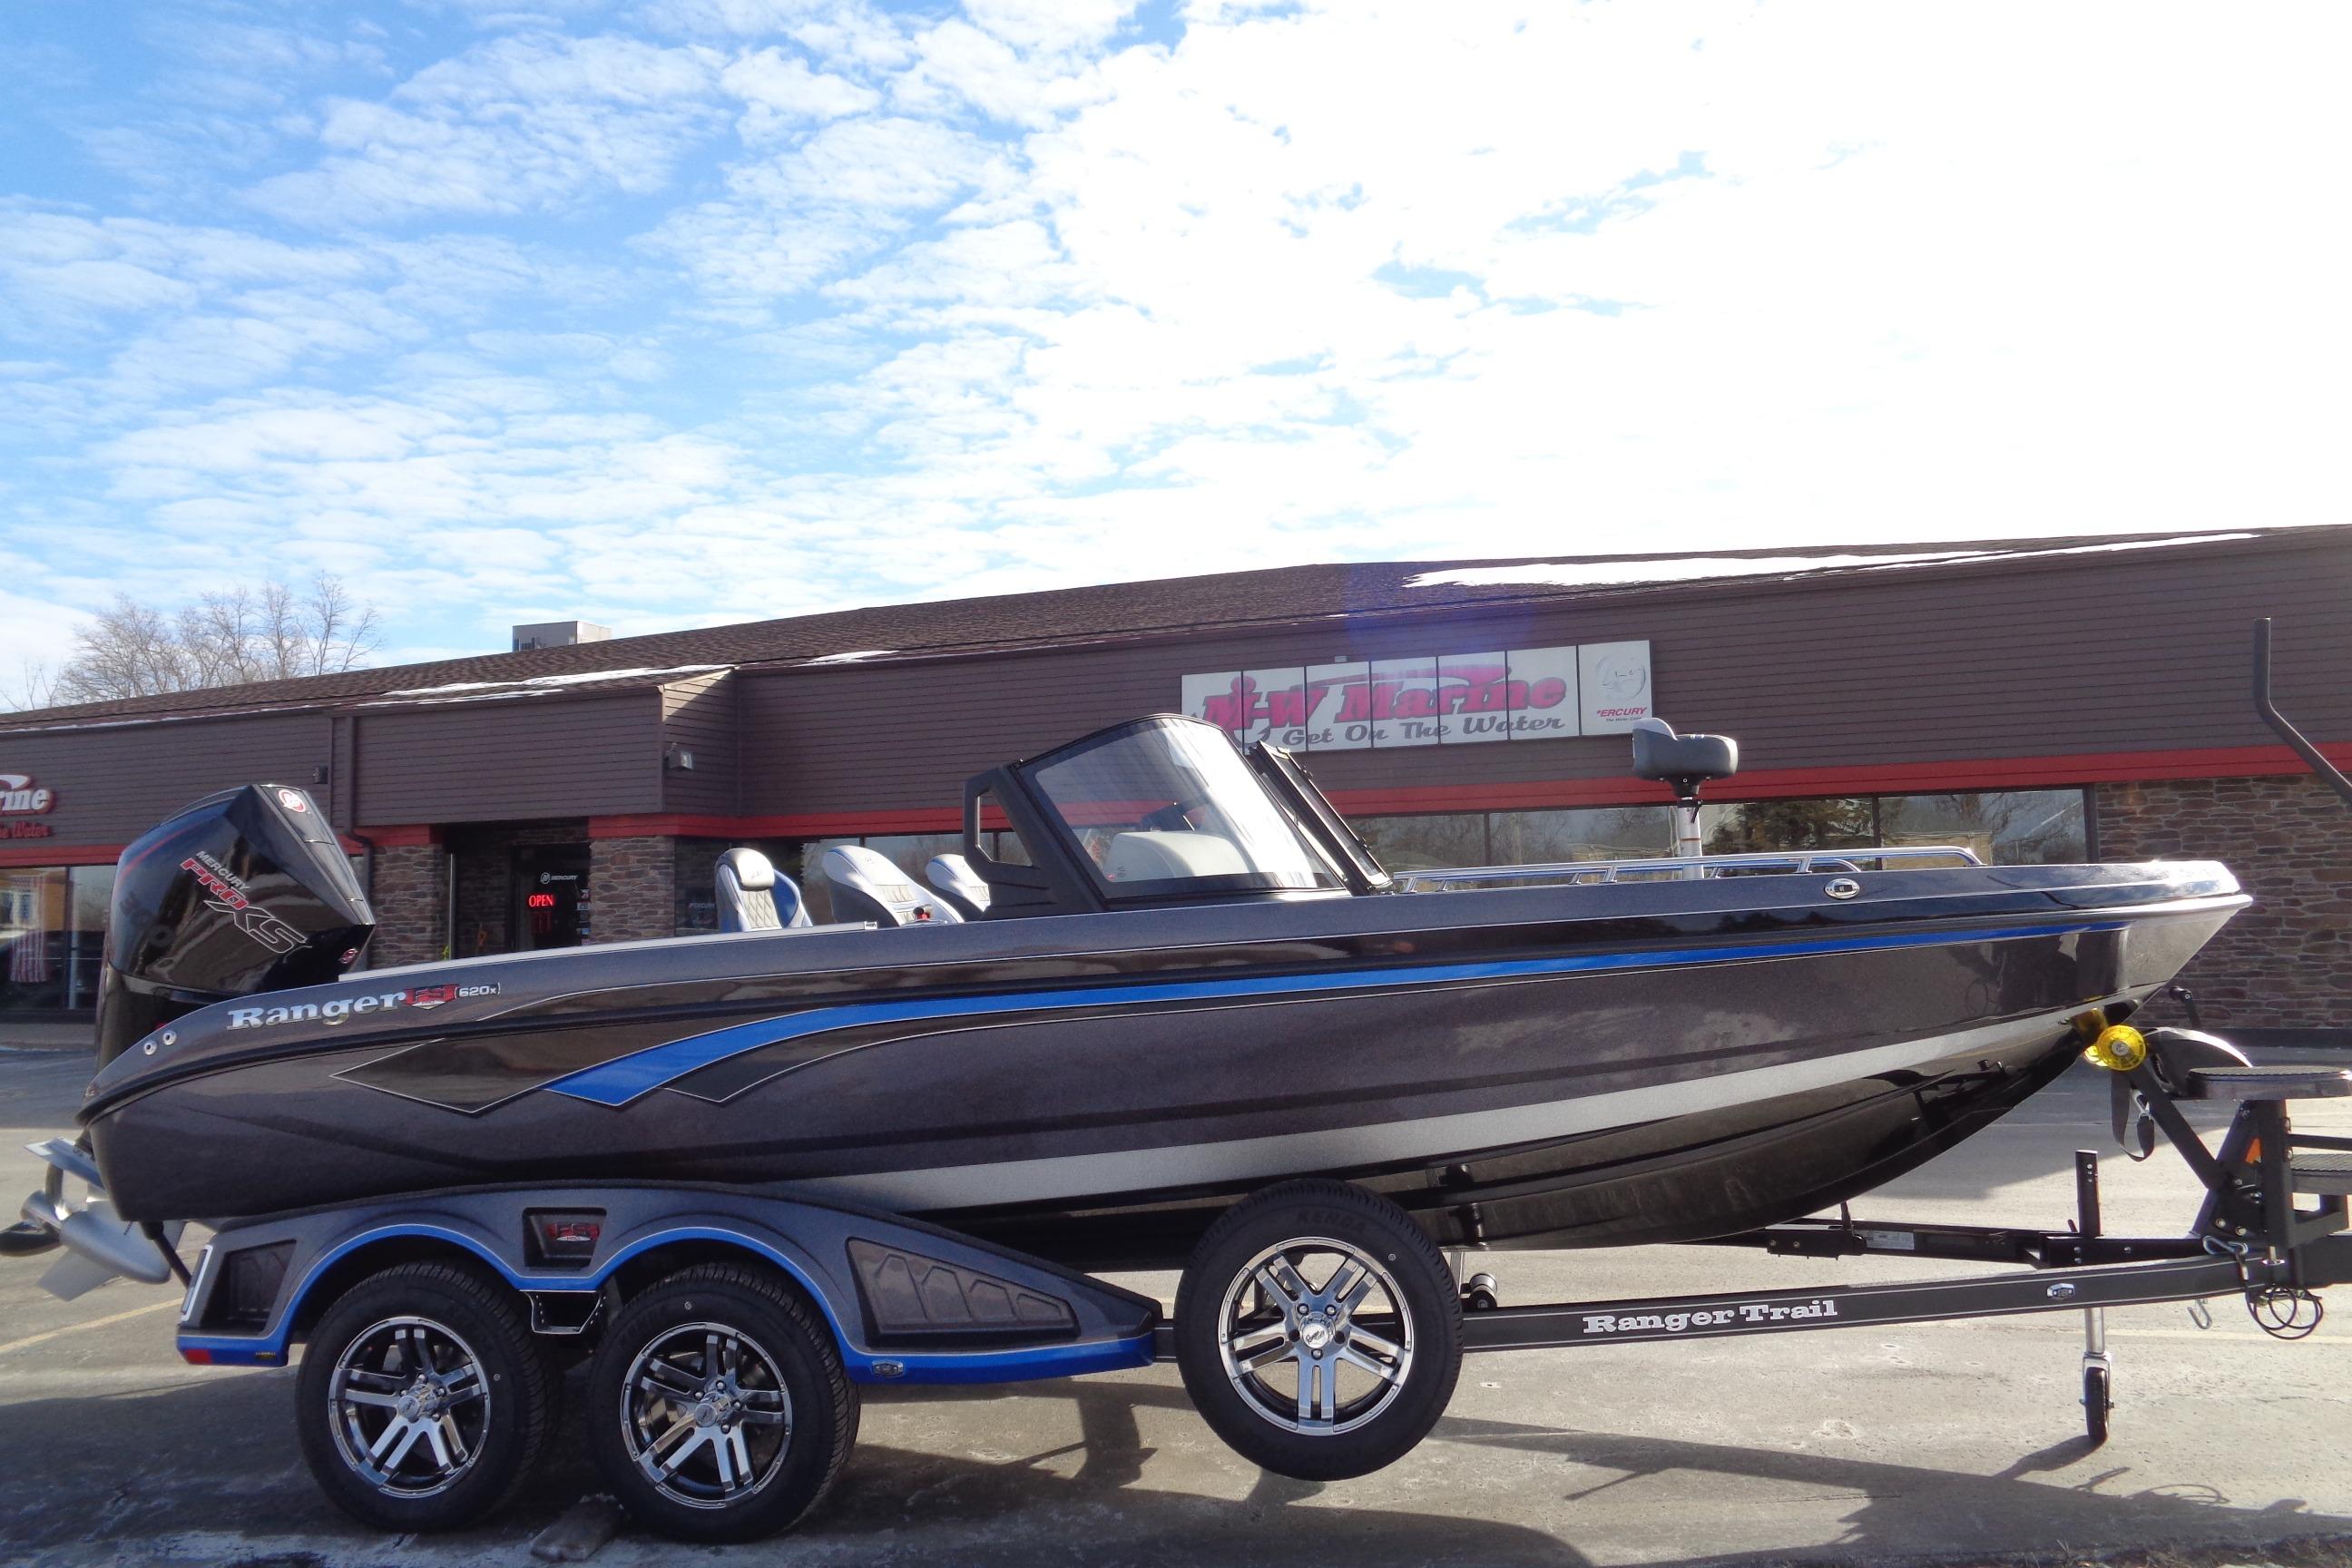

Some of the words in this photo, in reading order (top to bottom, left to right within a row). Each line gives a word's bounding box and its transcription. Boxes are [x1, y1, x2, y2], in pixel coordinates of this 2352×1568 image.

[1334, 677, 1567, 725] Marine
[1282, 728, 1335, 746] Get
[1345, 724, 1389, 742] On
[1399, 720, 1452, 740] The
[1463, 715, 1566, 735] Water
[180, 858, 250, 910] PRO
[196, 850, 250, 890] MERCURY
[528, 894, 554, 907] OPEN
[203, 900, 309, 954] XS
[227, 992, 406, 1031] Ranger
[1583, 1309, 1734, 1333] Ranger
[1740, 1300, 1838, 1322] Trail
